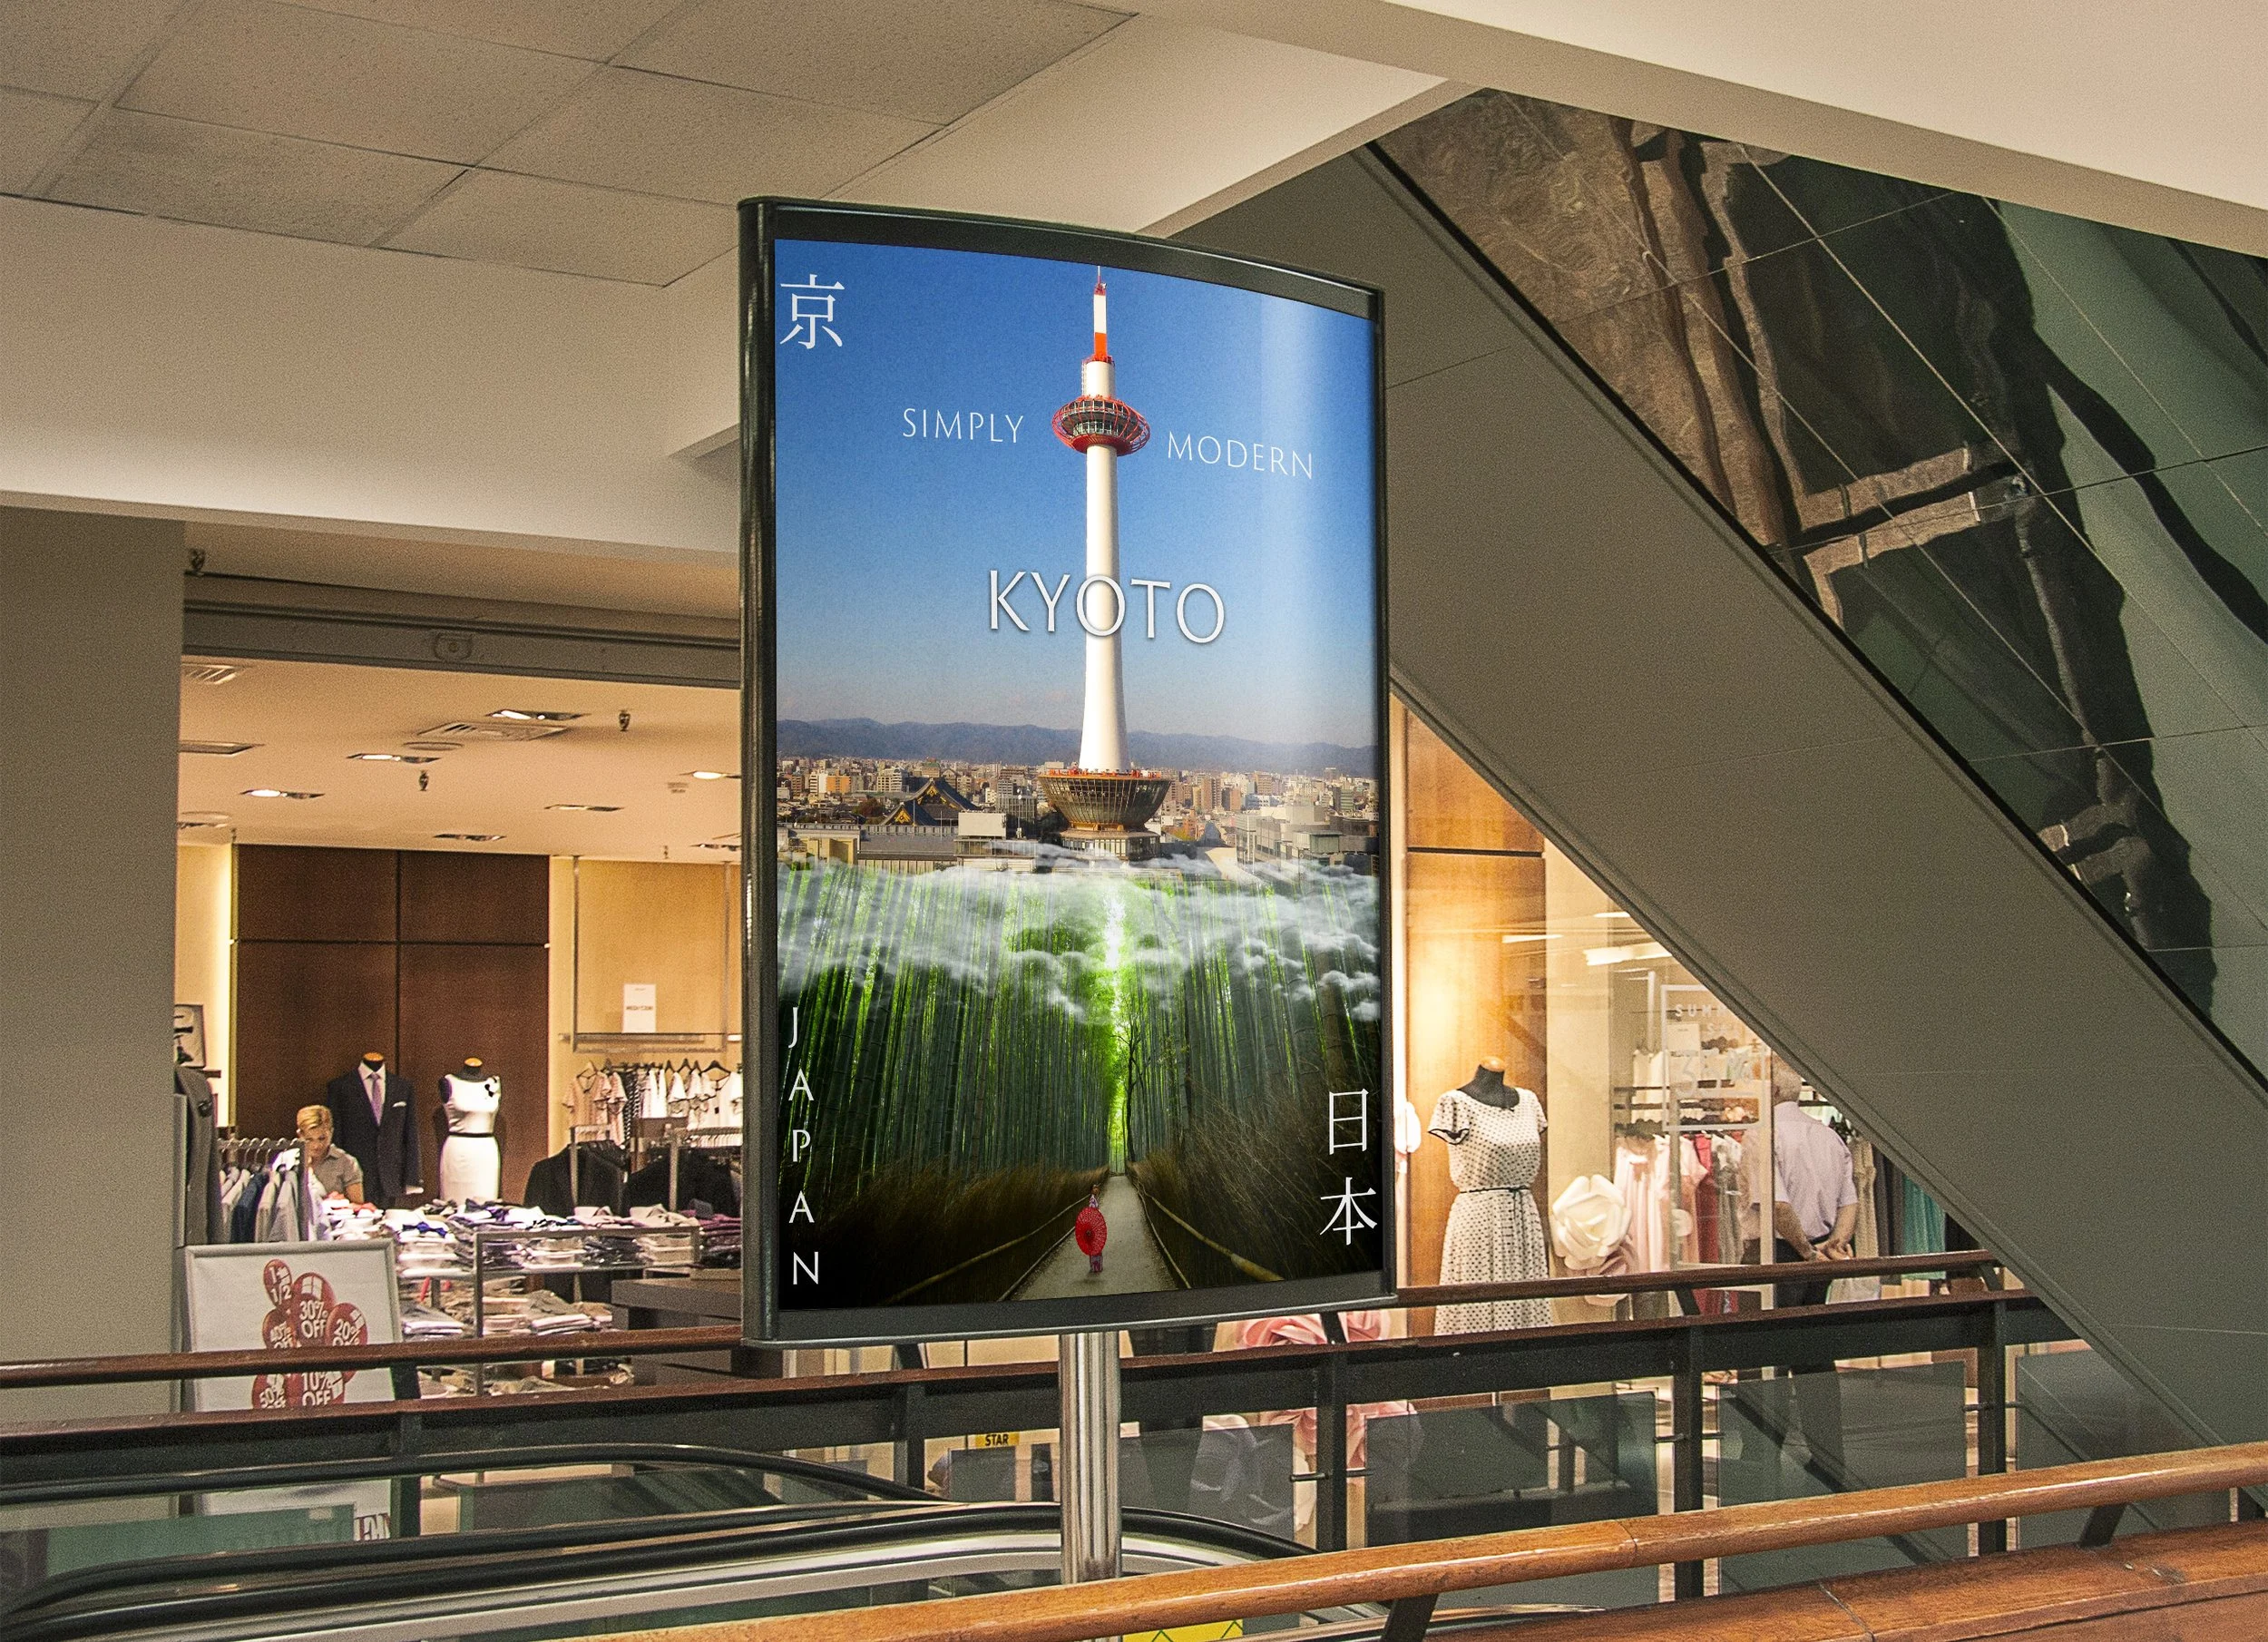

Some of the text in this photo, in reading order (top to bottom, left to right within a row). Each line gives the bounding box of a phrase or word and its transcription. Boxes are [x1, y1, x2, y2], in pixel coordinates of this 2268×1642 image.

[780, 273, 845, 349] 京
[903, 408, 1313, 479] SIMPLY MODERN
[990, 569, 1226, 644] KYOTO
[788, 1006, 819, 1285] JAPAN
[1320, 1089, 1377, 1246] 日本
[299, 1299, 328, 1320] 30%
[301, 1319, 327, 1338] OFF
[333, 1318, 361, 1344] 20%
[302, 1390, 331, 1406] OFF
[985, 1433, 1009, 1447] STAR
